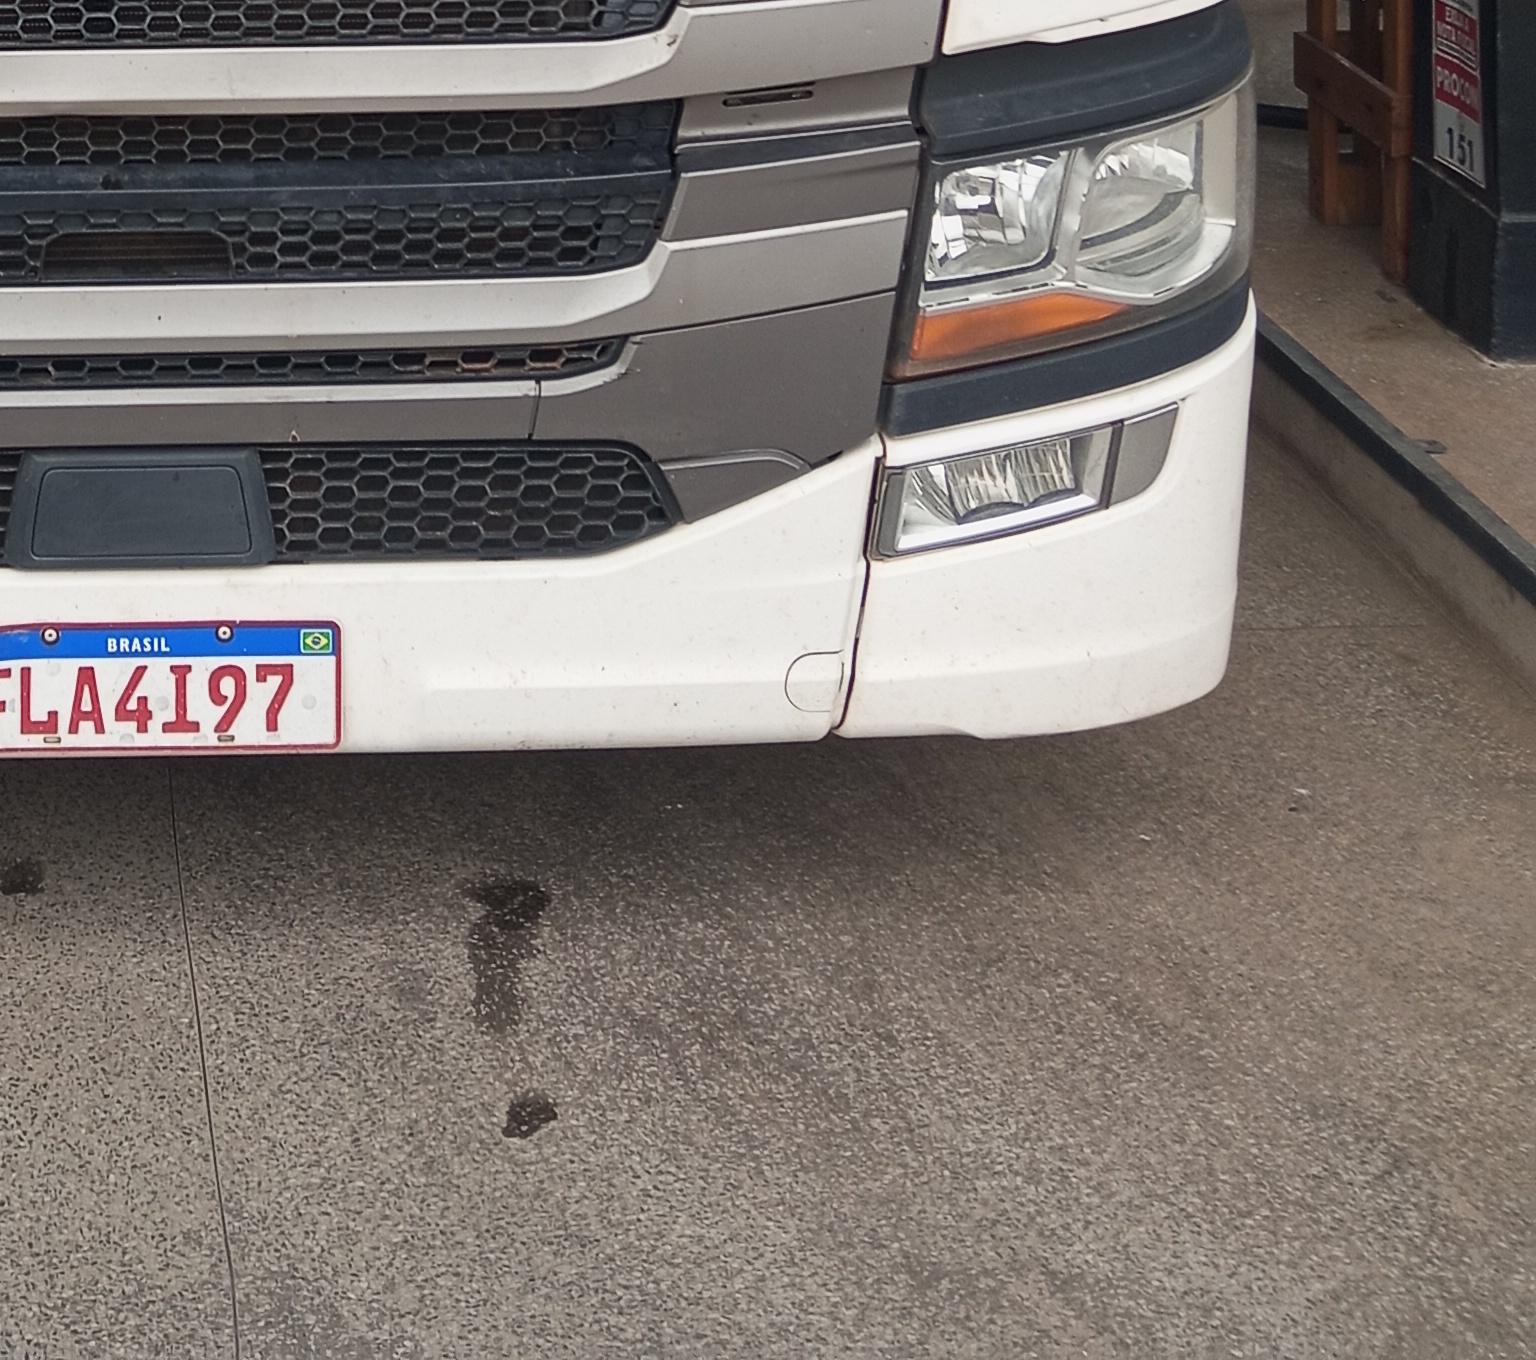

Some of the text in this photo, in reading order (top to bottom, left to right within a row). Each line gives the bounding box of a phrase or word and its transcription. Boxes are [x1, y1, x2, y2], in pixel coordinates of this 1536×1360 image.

[1436, 66, 1479, 110] PROCON
[1446, 127, 1474, 173] 151
[107, 637, 170, 653] BRASIL
